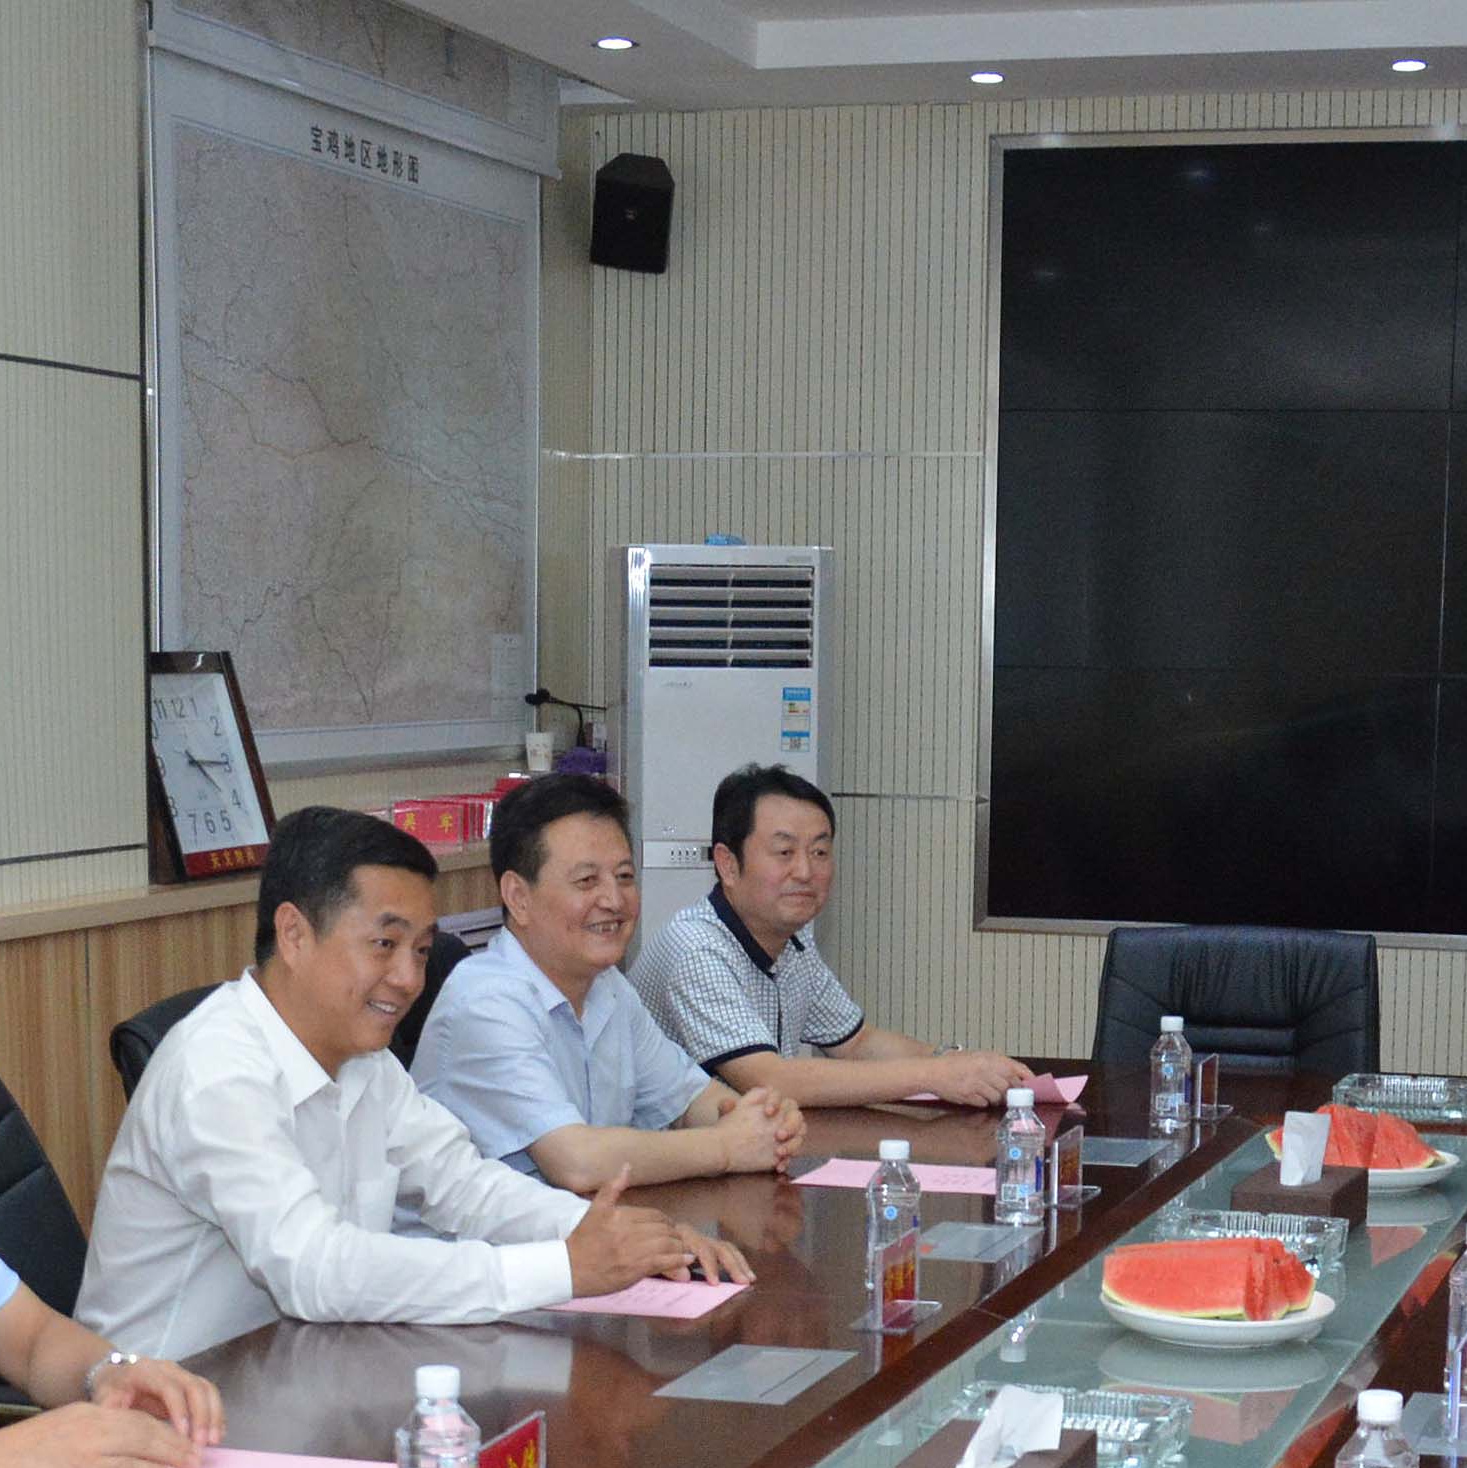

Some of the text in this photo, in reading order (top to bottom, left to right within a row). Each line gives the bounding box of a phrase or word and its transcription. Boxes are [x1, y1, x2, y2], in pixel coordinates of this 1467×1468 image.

[309, 122, 420, 184] 宝鸡地区地形图
[170, 698, 186, 719] 12
[210, 715, 222, 737] 2
[221, 752, 232, 774] 3
[231, 788, 242, 809] 4
[188, 813, 199, 837] 7
[205, 811, 216, 834] 6
[220, 809, 232, 832] 5
